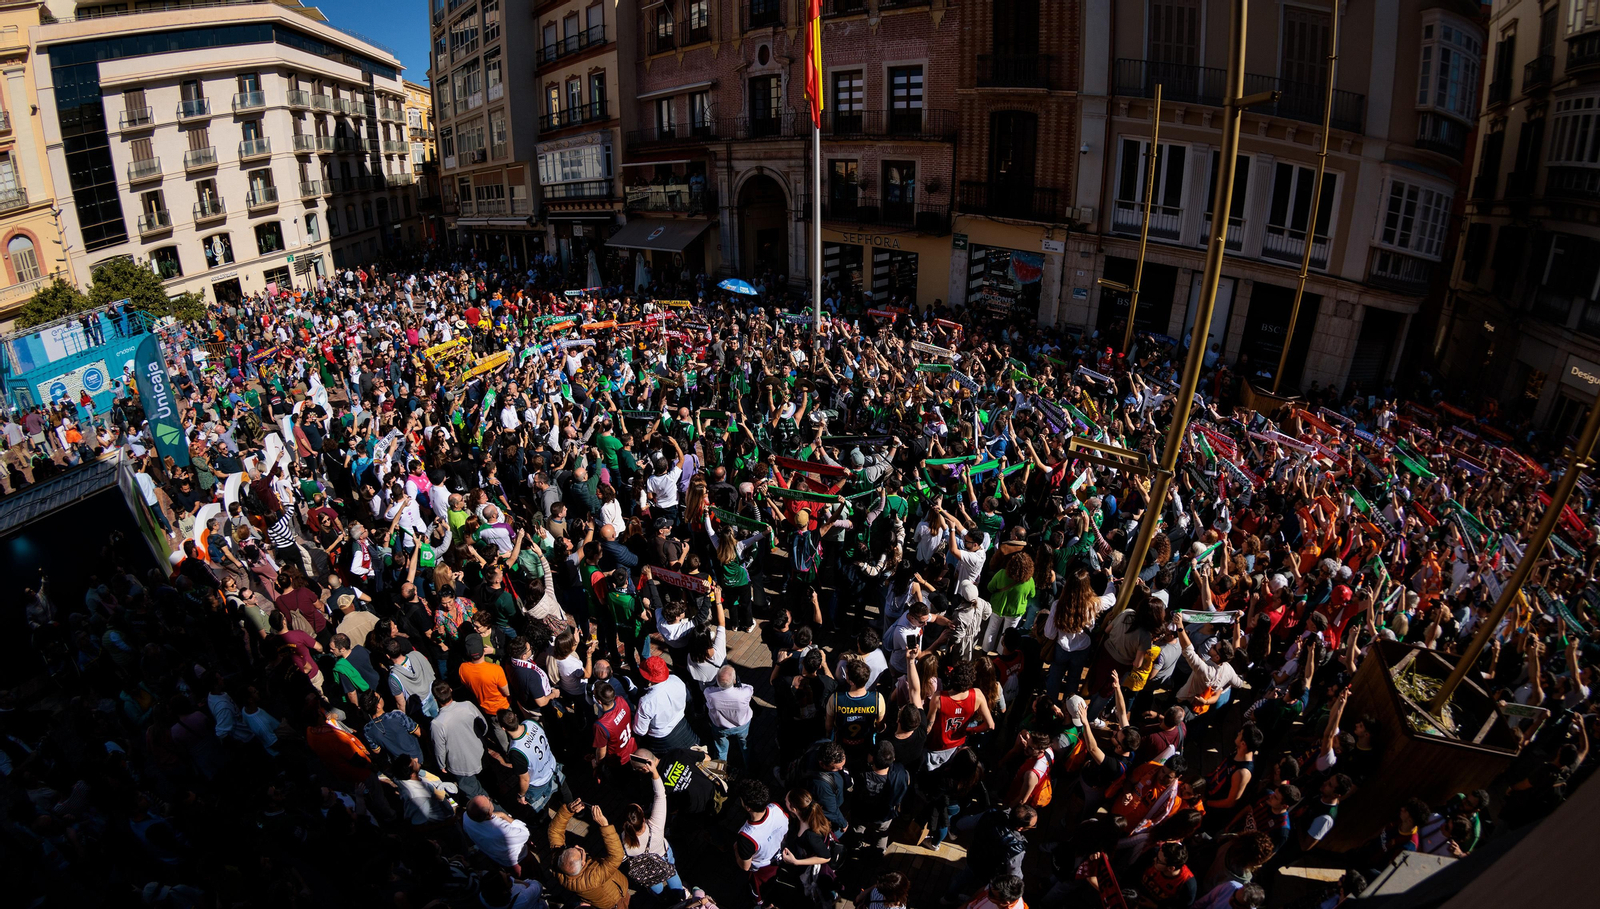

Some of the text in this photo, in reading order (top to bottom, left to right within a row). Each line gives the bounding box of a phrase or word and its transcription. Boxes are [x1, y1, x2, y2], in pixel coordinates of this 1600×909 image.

[842, 232, 901, 249] SEPHORA
[1117, 297, 1131, 308] BS
[51, 321, 83, 337] endes
[1261, 322, 1281, 335] BSC
[147, 361, 171, 419] Unicaja
[776, 488, 804, 499] UNICAJA
[613, 708, 627, 727] ENNIS
[838, 704, 876, 716] POTAPENKO
[524, 724, 540, 749] ONUAKU
[848, 723, 860, 738] 9
[533, 734, 550, 762] 32
[664, 761, 685, 786] VANS
